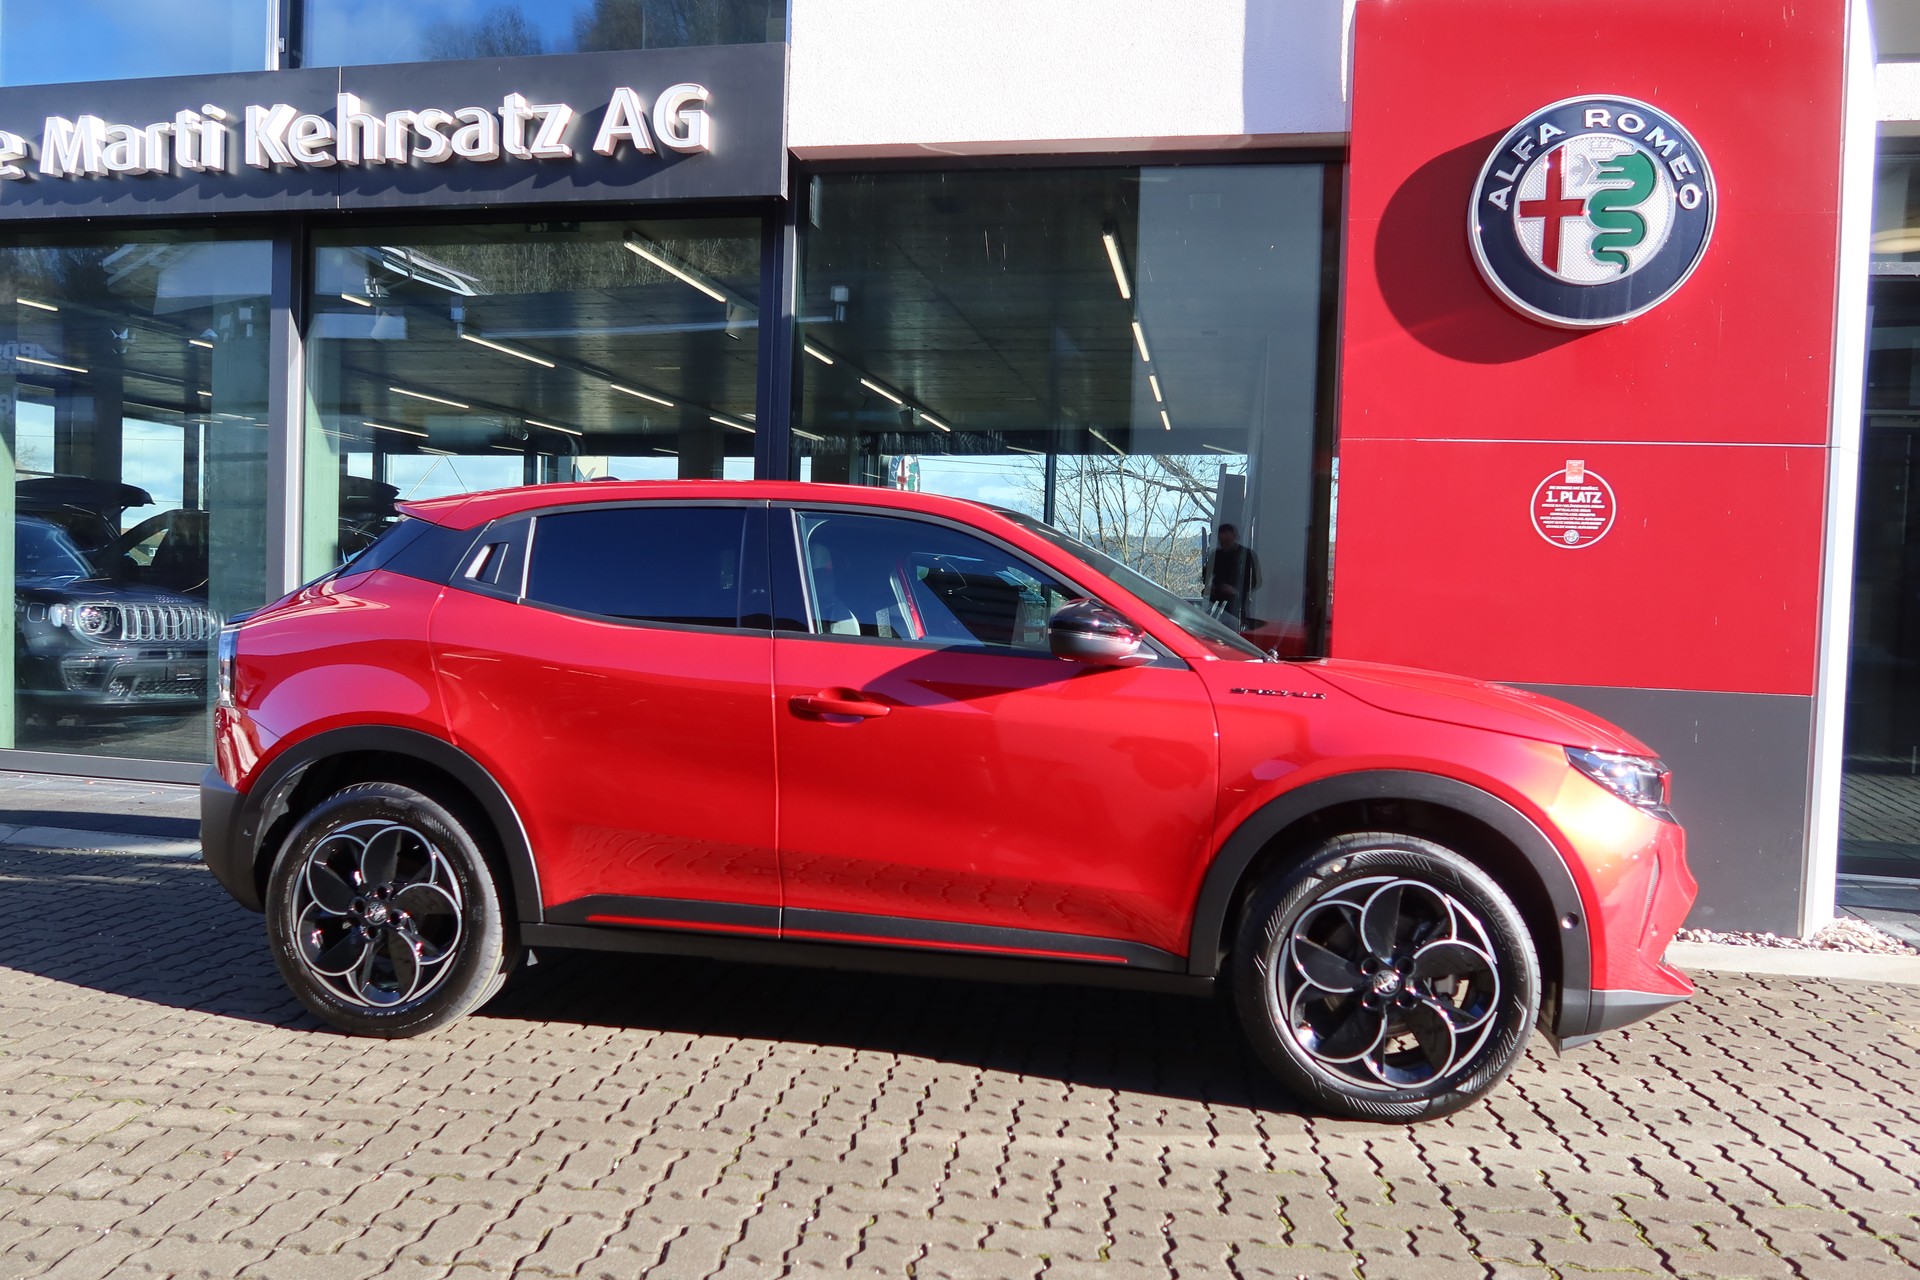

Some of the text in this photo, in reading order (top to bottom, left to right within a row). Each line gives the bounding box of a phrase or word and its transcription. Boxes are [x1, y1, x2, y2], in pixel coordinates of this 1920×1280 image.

[40, 103, 227, 178] Marti
[245, 93, 573, 169] Kehrsatz
[593, 82, 710, 156] AG
[1488, 108, 1704, 211] ALFA ROMEO
[1559, 491, 1603, 504] PLATZ
